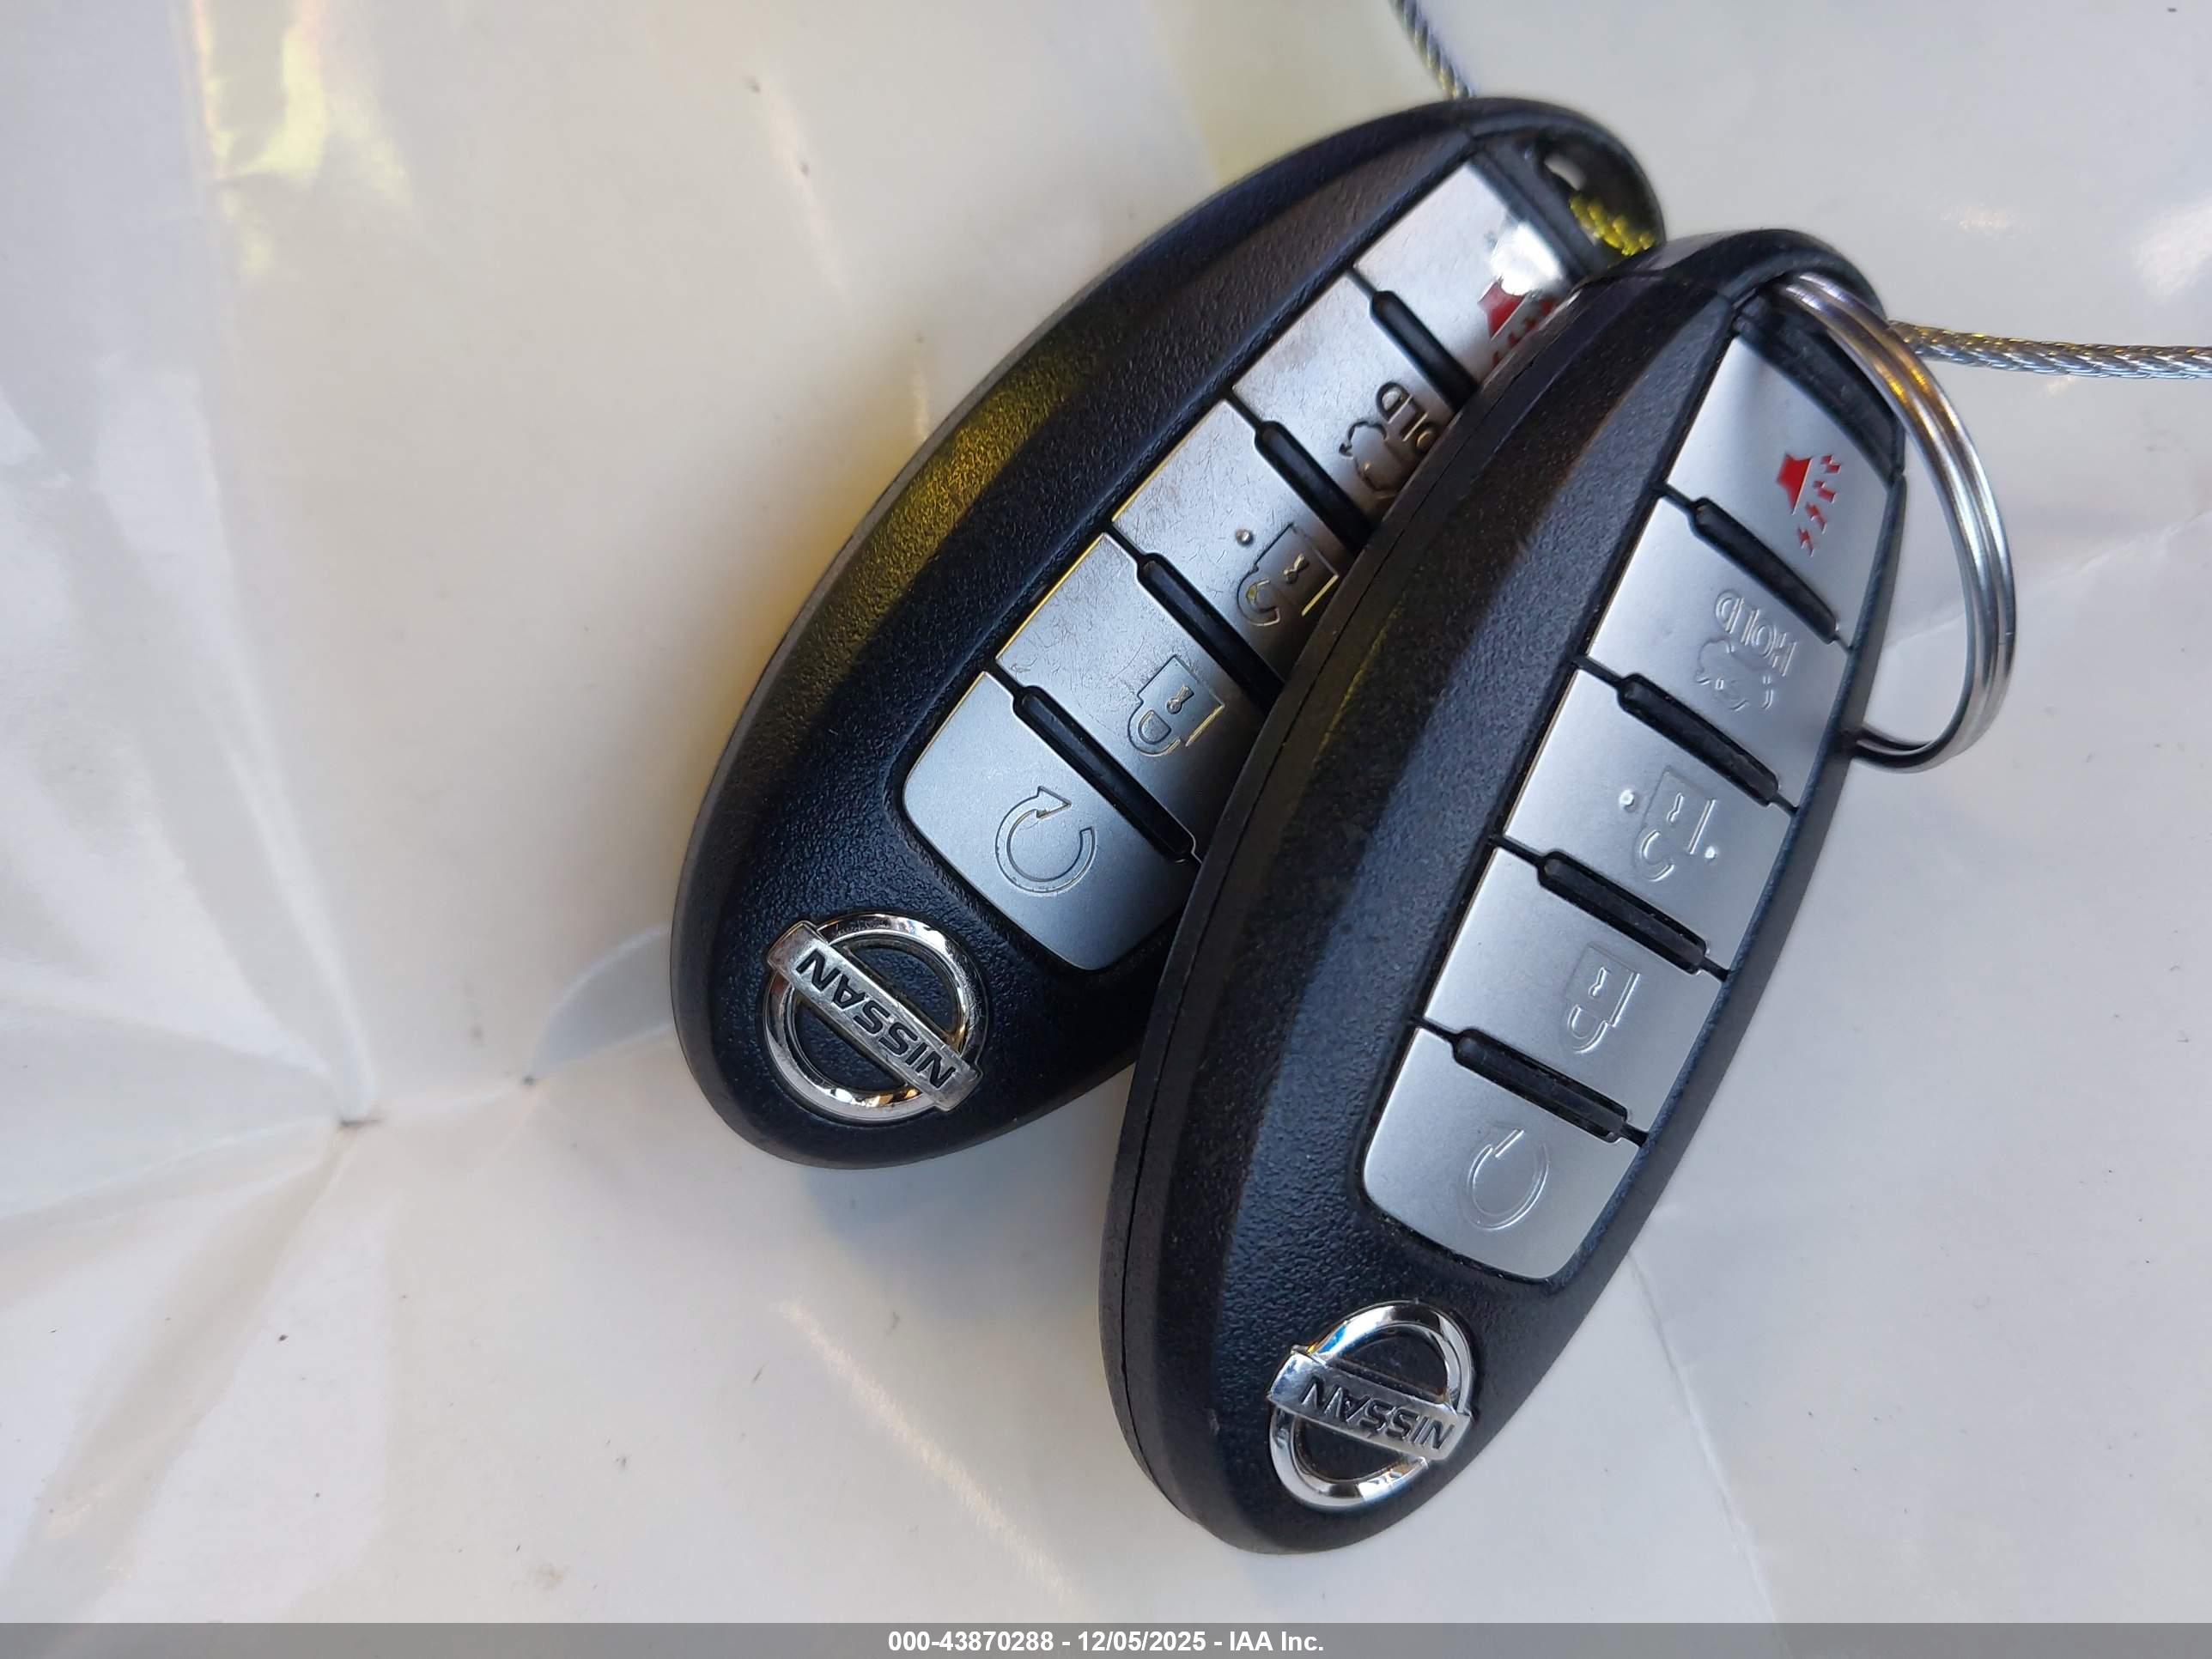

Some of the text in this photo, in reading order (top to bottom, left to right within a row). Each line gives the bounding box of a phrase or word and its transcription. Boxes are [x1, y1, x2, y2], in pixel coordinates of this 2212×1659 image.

[1715, 589, 1797, 677] HOLD
[795, 948, 955, 1089] NISSAN
[1298, 1376, 1455, 1450] NISSAN
